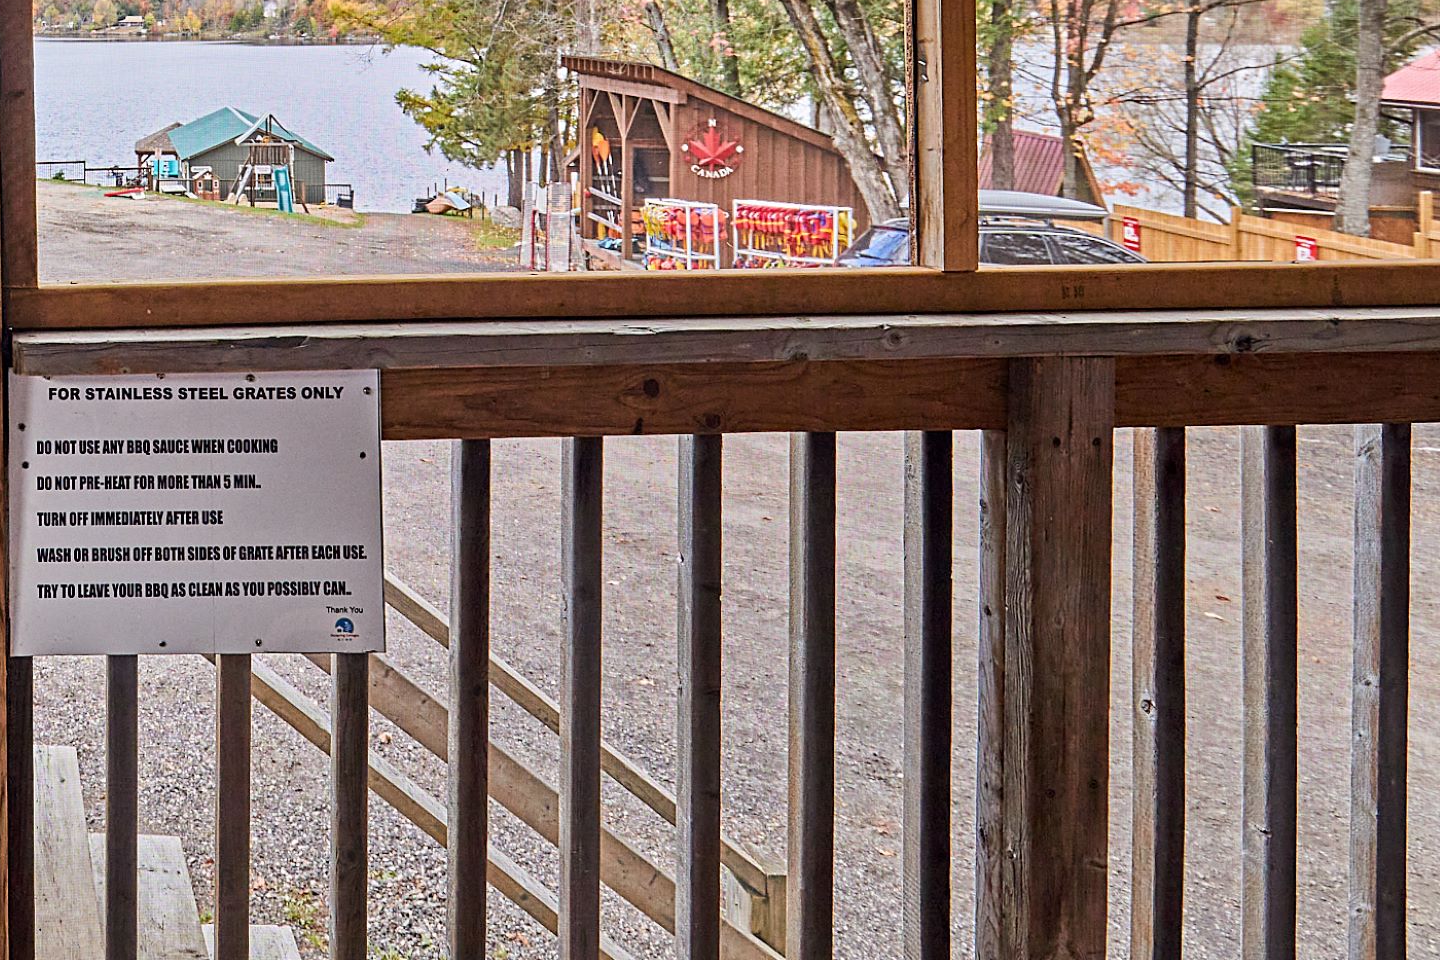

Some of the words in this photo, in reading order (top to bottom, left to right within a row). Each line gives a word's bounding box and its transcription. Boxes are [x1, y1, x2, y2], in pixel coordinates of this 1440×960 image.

[708, 118, 717, 127] N
[690, 164, 734, 179] CANADA
[48, 387, 81, 401] FOR
[84, 387, 173, 401] STAINLESS
[177, 387, 229, 400] STEEL
[232, 386, 297, 400] GRATES
[300, 386, 345, 400] ONLY
[36, 439, 52, 455] DO
[54, 439, 77, 455] NOT
[78, 439, 101, 455] USE
[102, 439, 125, 455] ANY
[126, 439, 151, 456] BBQ
[152, 439, 190, 454] SAUCE
[190, 438, 225, 454] WHEN
[226, 438, 279, 454] COOKING
[36, 475, 53, 491] DO
[54, 475, 78, 491] NOT
[79, 475, 132, 491] PRE-HEAT
[133, 474, 155, 490] FOR
[157, 474, 190, 490] MORE
[190, 474, 222, 490] THAN
[223, 474, 232, 490] 5
[36, 511, 67, 527] TURN
[69, 511, 89, 527] OFF
[90, 510, 164, 526] IMMEDIATELY
[165, 510, 200, 526] AFTER
[201, 509, 224, 526] USE
[36, 547, 72, 563] WASH
[73, 547, 89, 563] OR
[91, 546, 131, 562] BRUSH
[132, 546, 153, 562] OFF
[154, 546, 186, 562] BOTH
[187, 545, 221, 562] SIDES
[222, 545, 237, 561] OF
[238, 545, 274, 561] GRATE
[275, 545, 310, 561] AFTER
[311, 544, 341, 560] EACH
[342, 544, 368, 560] USE.
[36, 583, 59, 599] TRY
[60, 583, 76, 599] TO
[77, 583, 111, 599] LEAVE
[111, 582, 143, 598] YOUR
[144, 582, 169, 599] BBQ
[170, 582, 187, 598] AS
[188, 581, 223, 598] CLEAN
[224, 581, 241, 597] AS
[241, 581, 265, 597] YOU
[267, 580, 322, 597] POSSIBLY
[325, 605, 349, 614] Thank
[349, 606, 364, 614] You
